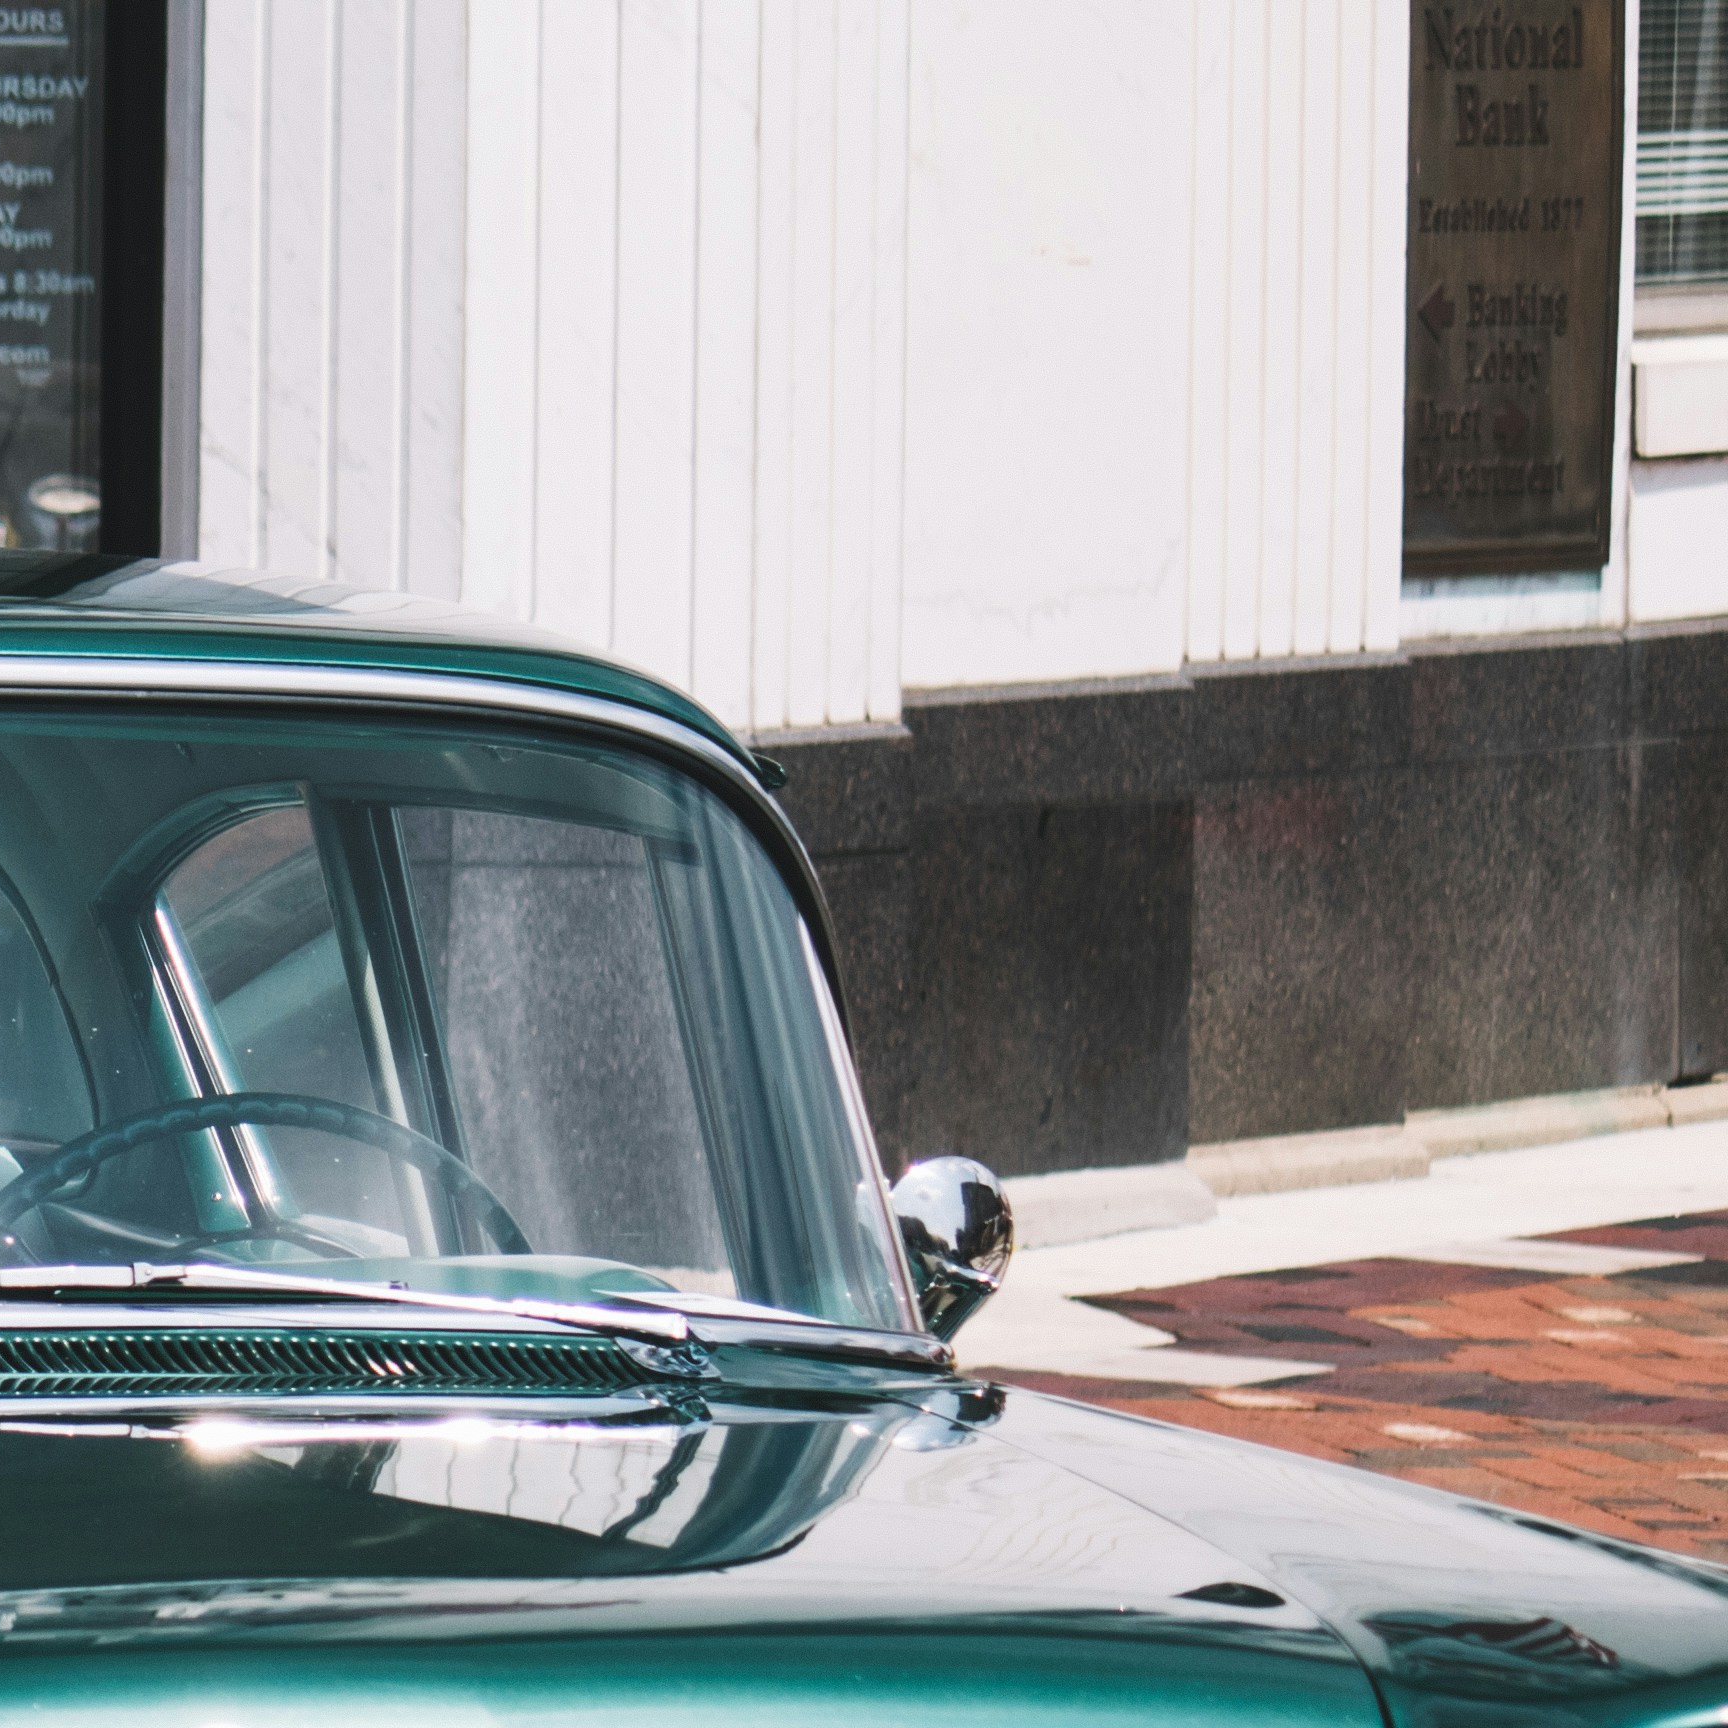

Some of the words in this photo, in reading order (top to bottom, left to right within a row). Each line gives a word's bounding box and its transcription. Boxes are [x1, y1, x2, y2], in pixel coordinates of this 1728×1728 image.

[1425, 8, 1585, 71] National
[1455, 84, 1551, 146] Bank
[1418, 197, 1530, 233] Established
[1467, 284, 1568, 336] Banking
